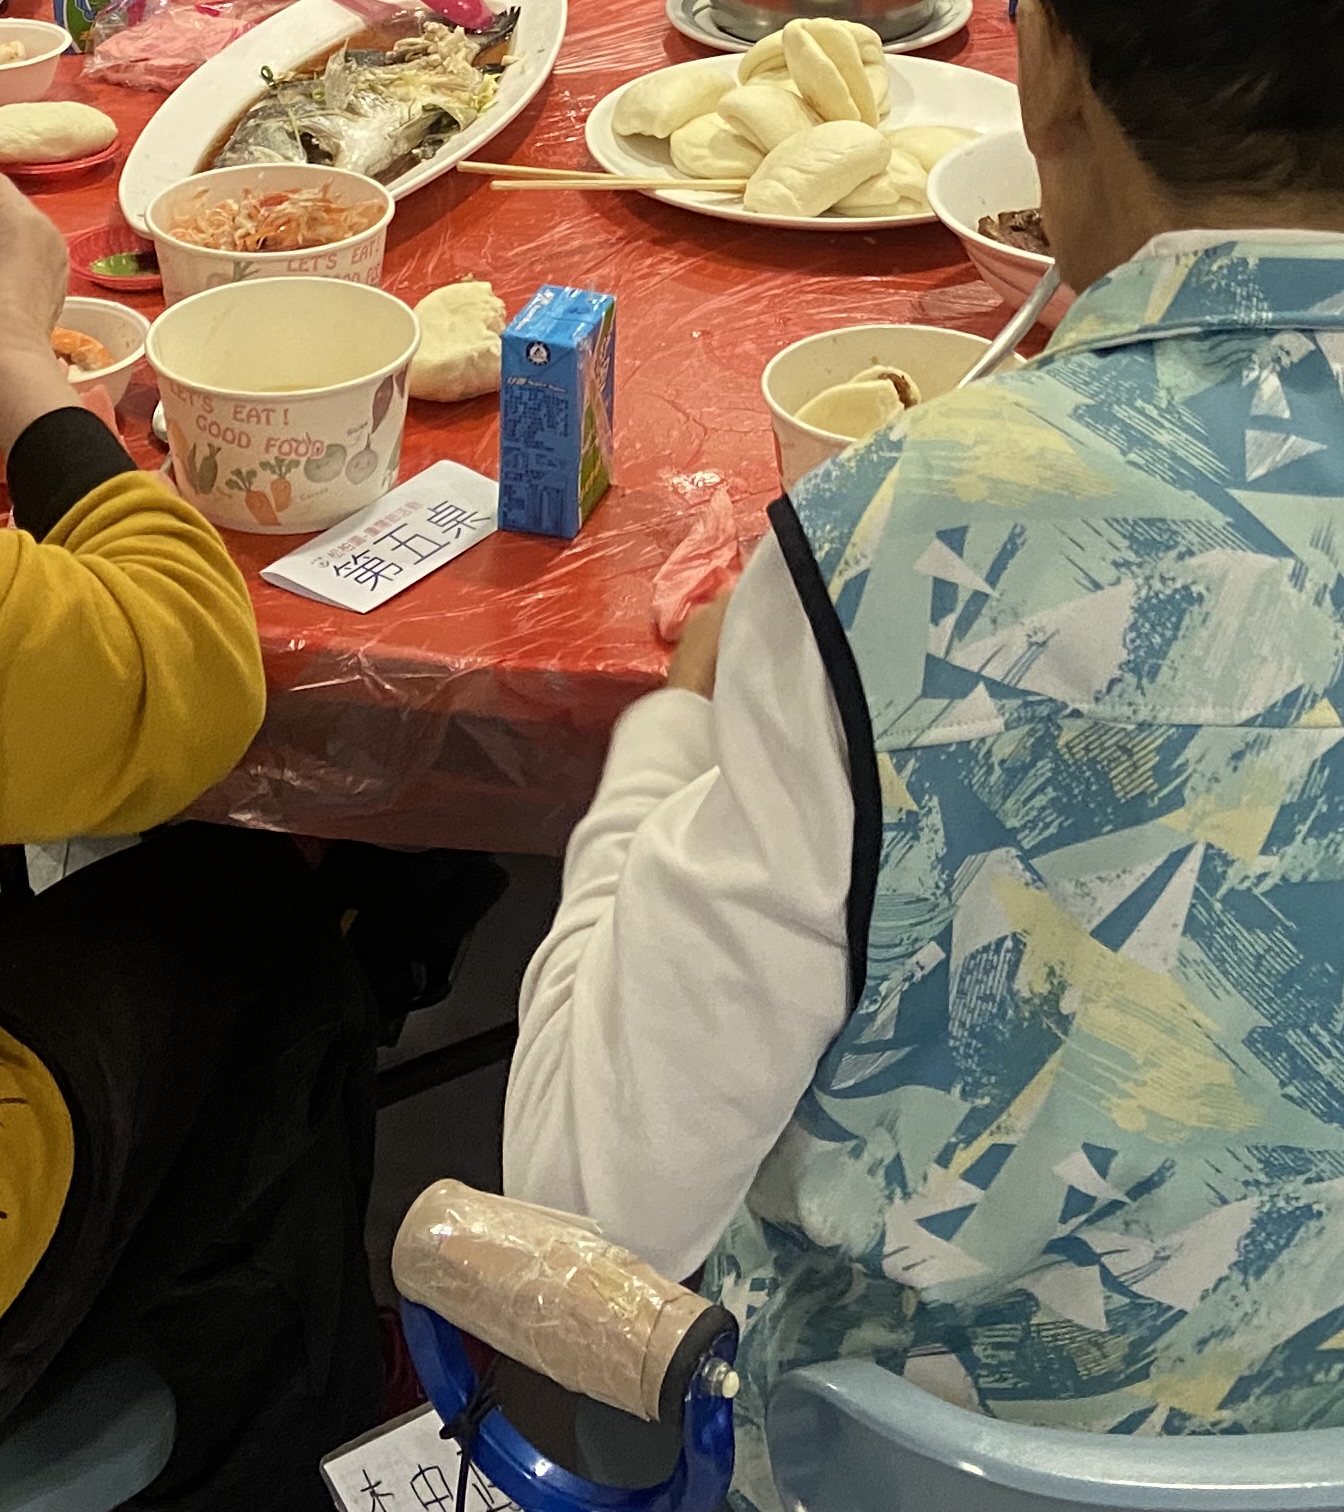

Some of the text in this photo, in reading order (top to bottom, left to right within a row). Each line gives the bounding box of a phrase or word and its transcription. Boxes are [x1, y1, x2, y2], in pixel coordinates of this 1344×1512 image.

[287, 252, 337, 272] LET'S
[170, 379, 214, 414] LET'S
[195, 414, 327, 458] GOOD FOOD
[333, 500, 492, 592] 第五桌
